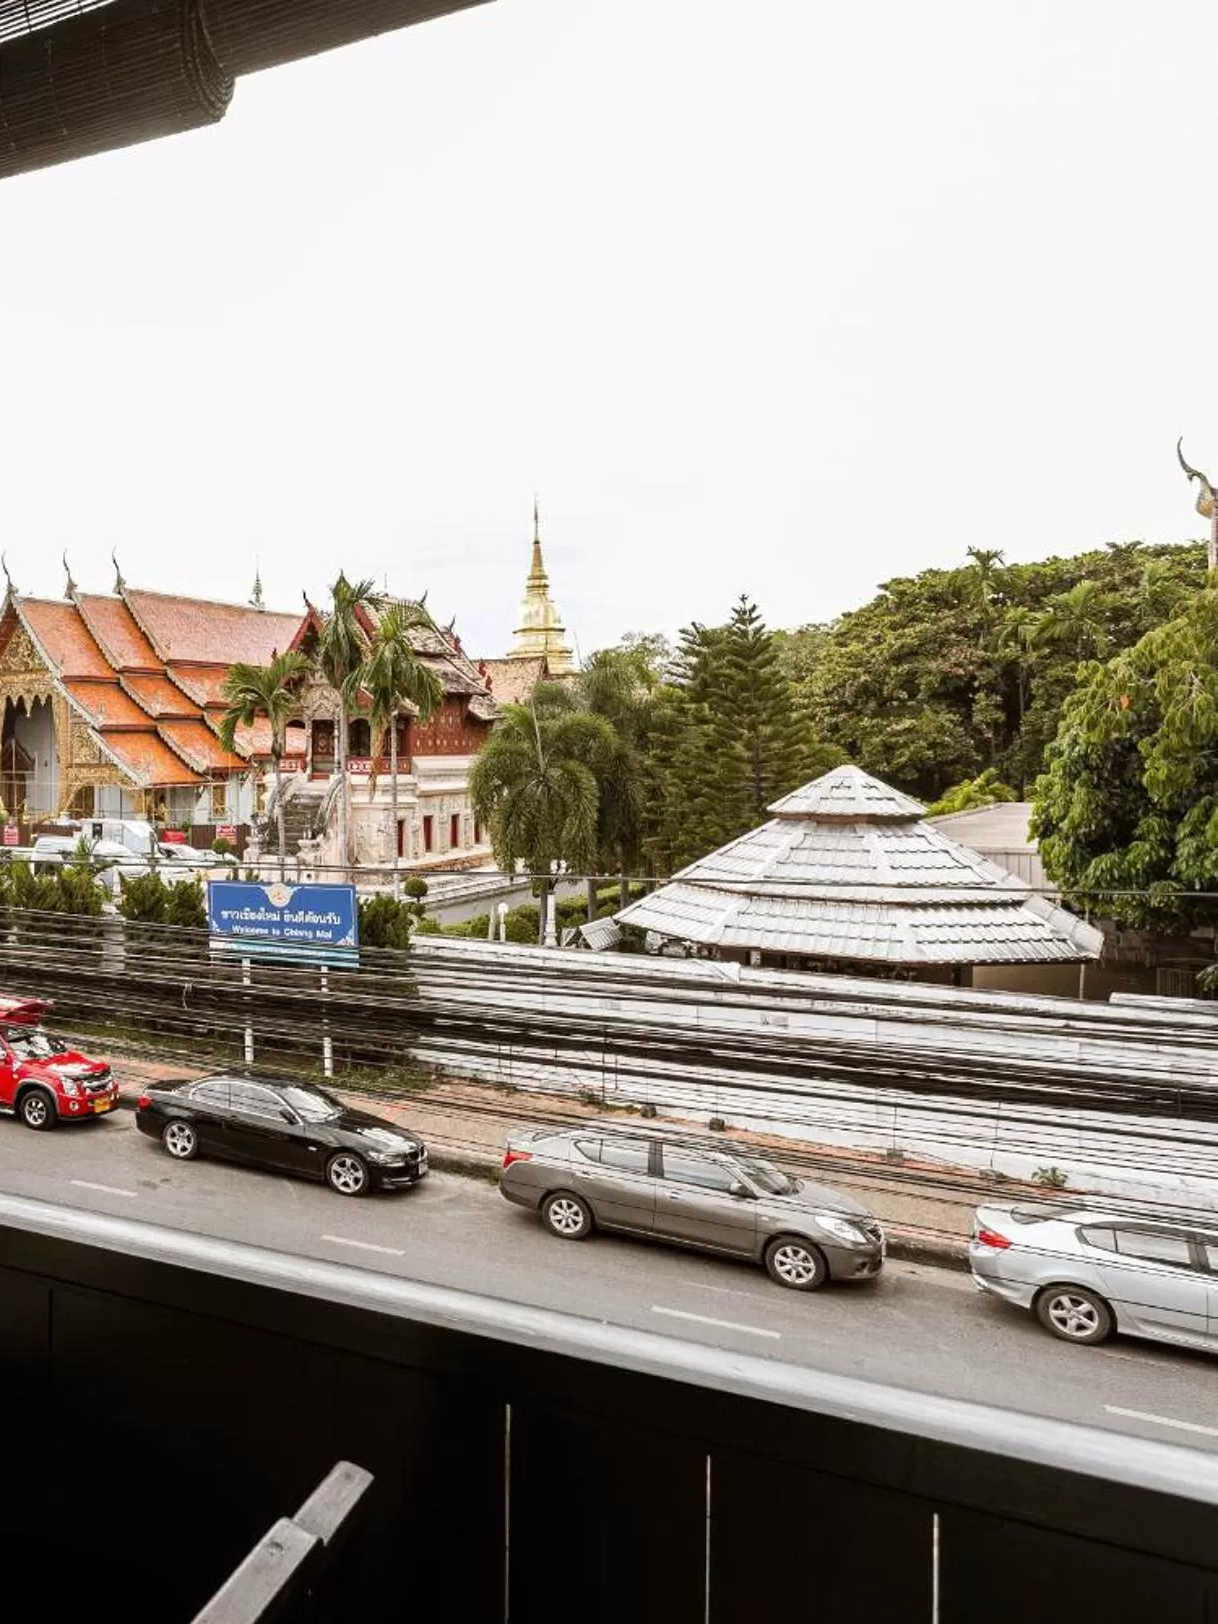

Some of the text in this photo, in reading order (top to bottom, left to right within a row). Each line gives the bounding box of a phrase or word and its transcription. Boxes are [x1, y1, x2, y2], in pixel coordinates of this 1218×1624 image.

[232, 925, 332, 939] Welcome to Chiang Mai
